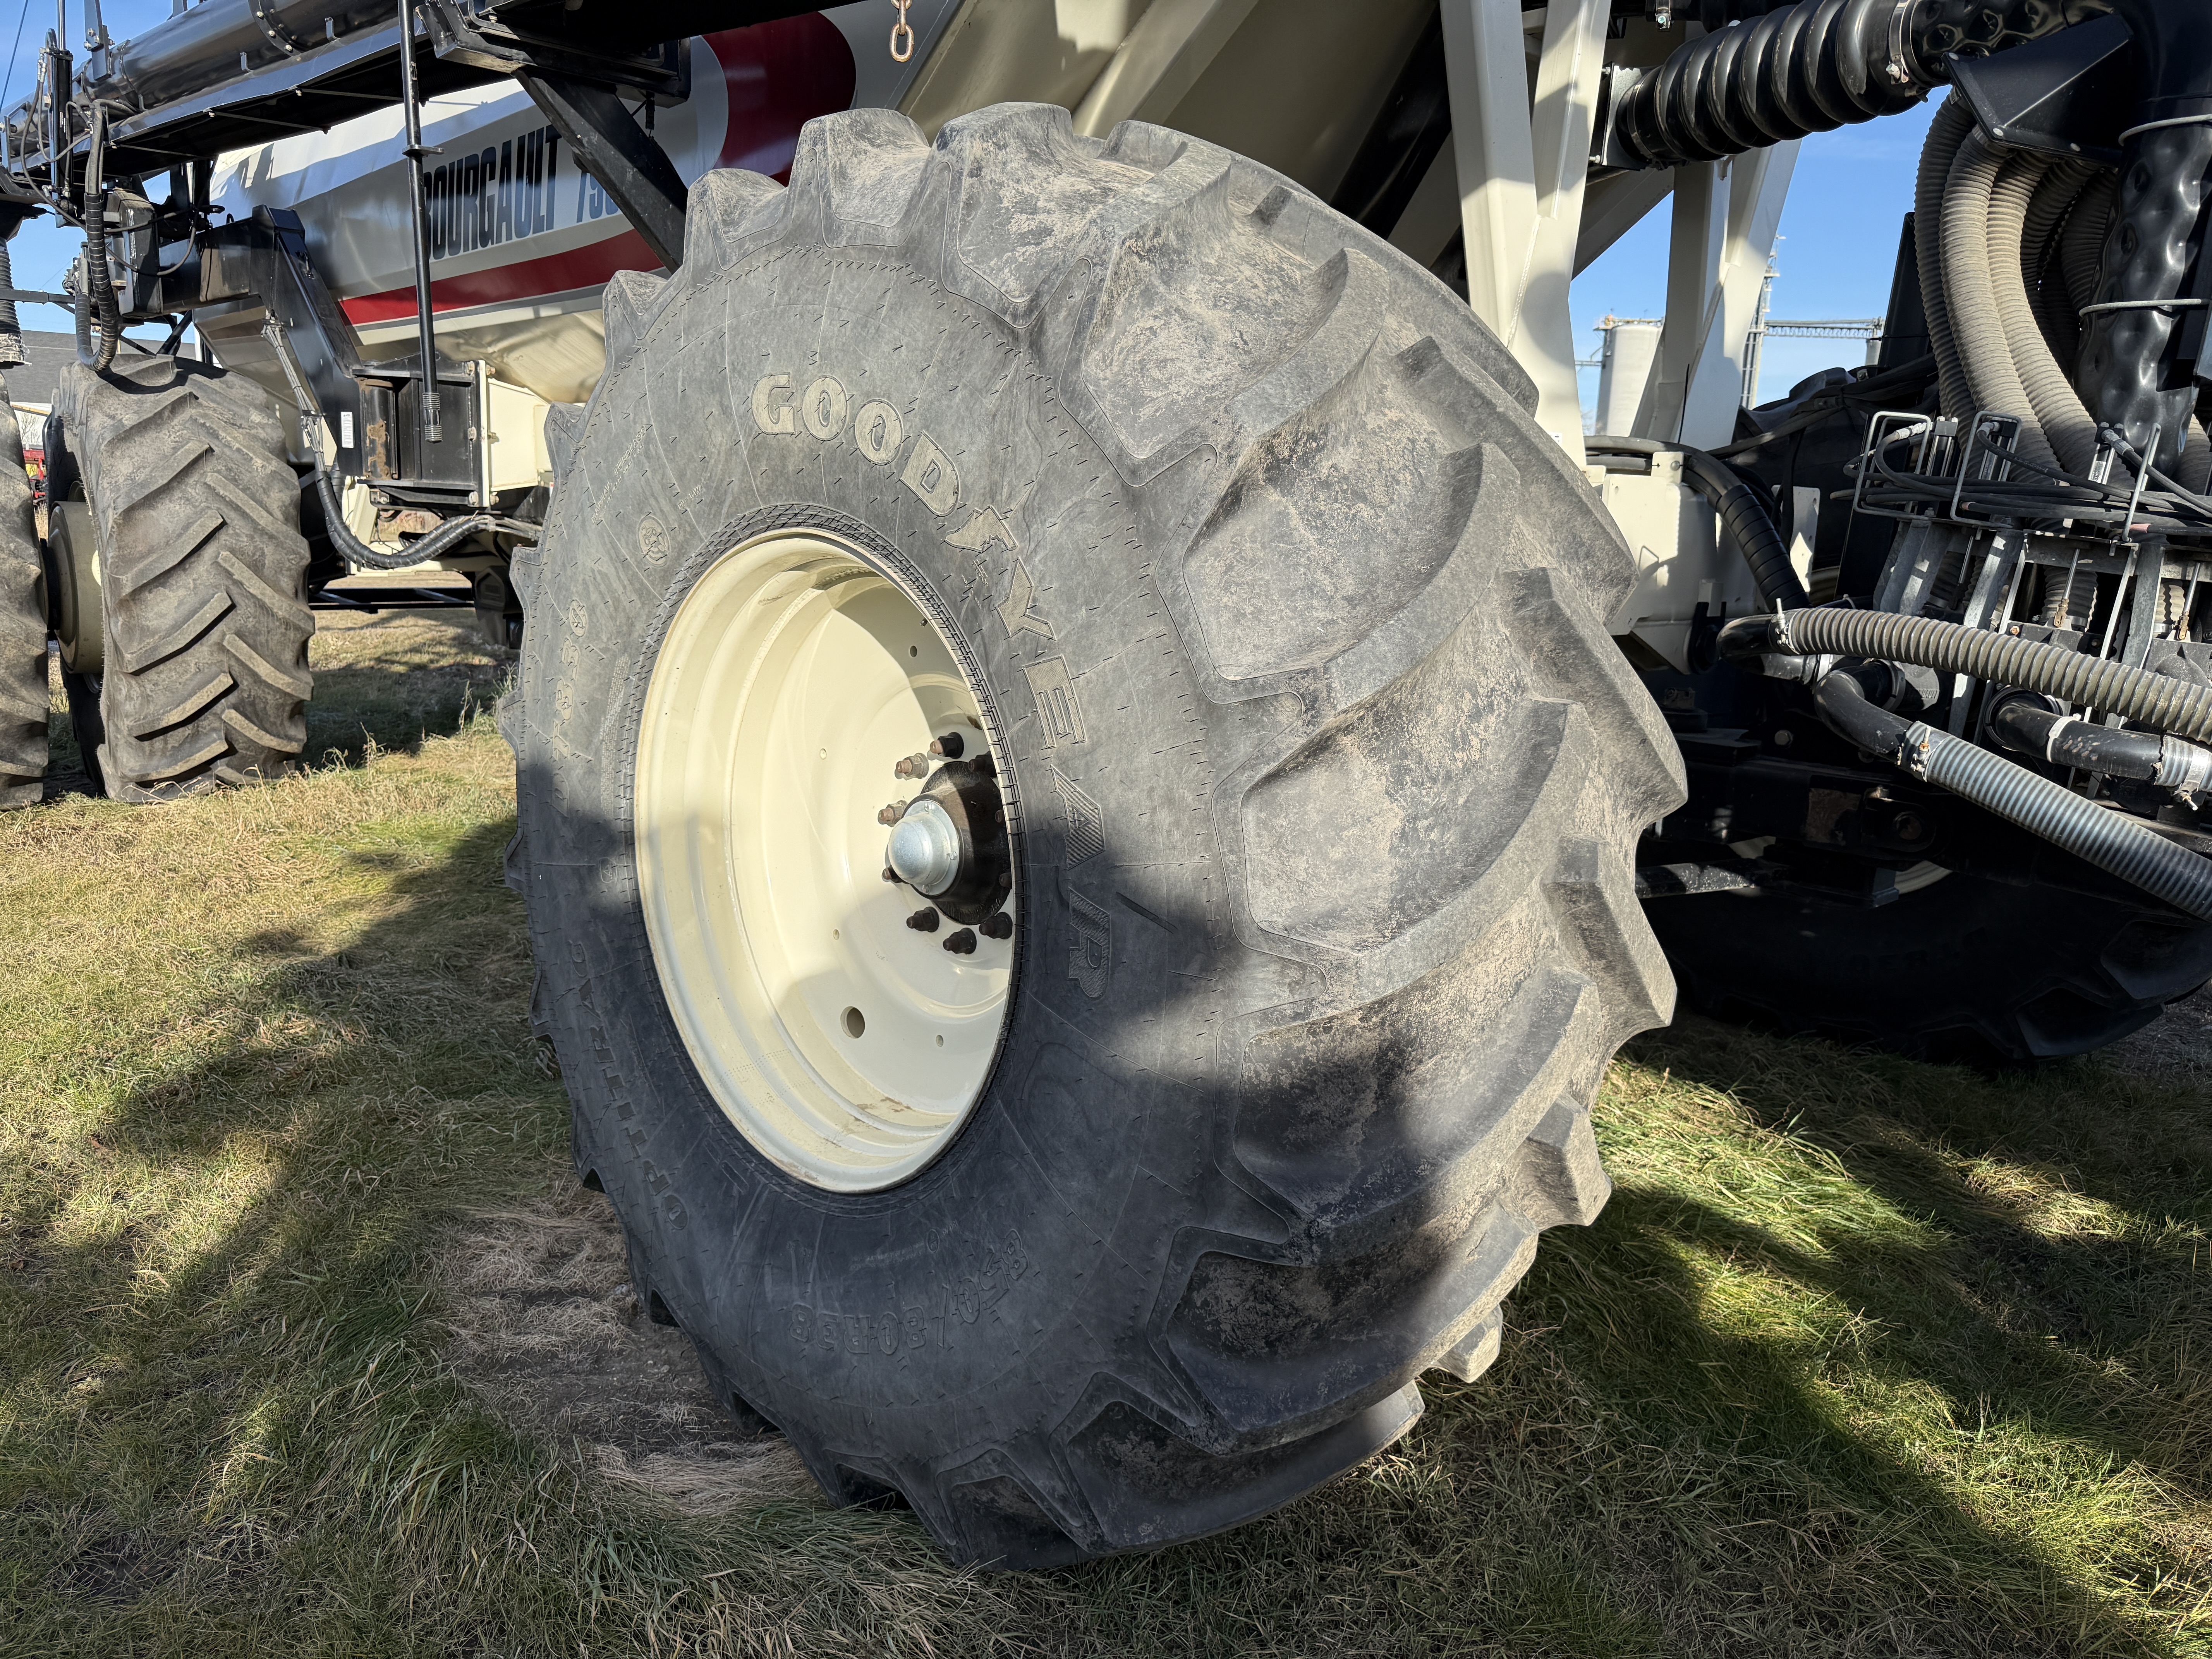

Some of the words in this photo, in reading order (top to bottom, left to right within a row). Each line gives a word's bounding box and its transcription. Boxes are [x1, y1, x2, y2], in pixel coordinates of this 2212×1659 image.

[750, 372, 1111, 1000] GOODYEAR
[568, 940, 689, 1230] OPTITRAC
[789, 1228, 1029, 1355] 850/80R38
